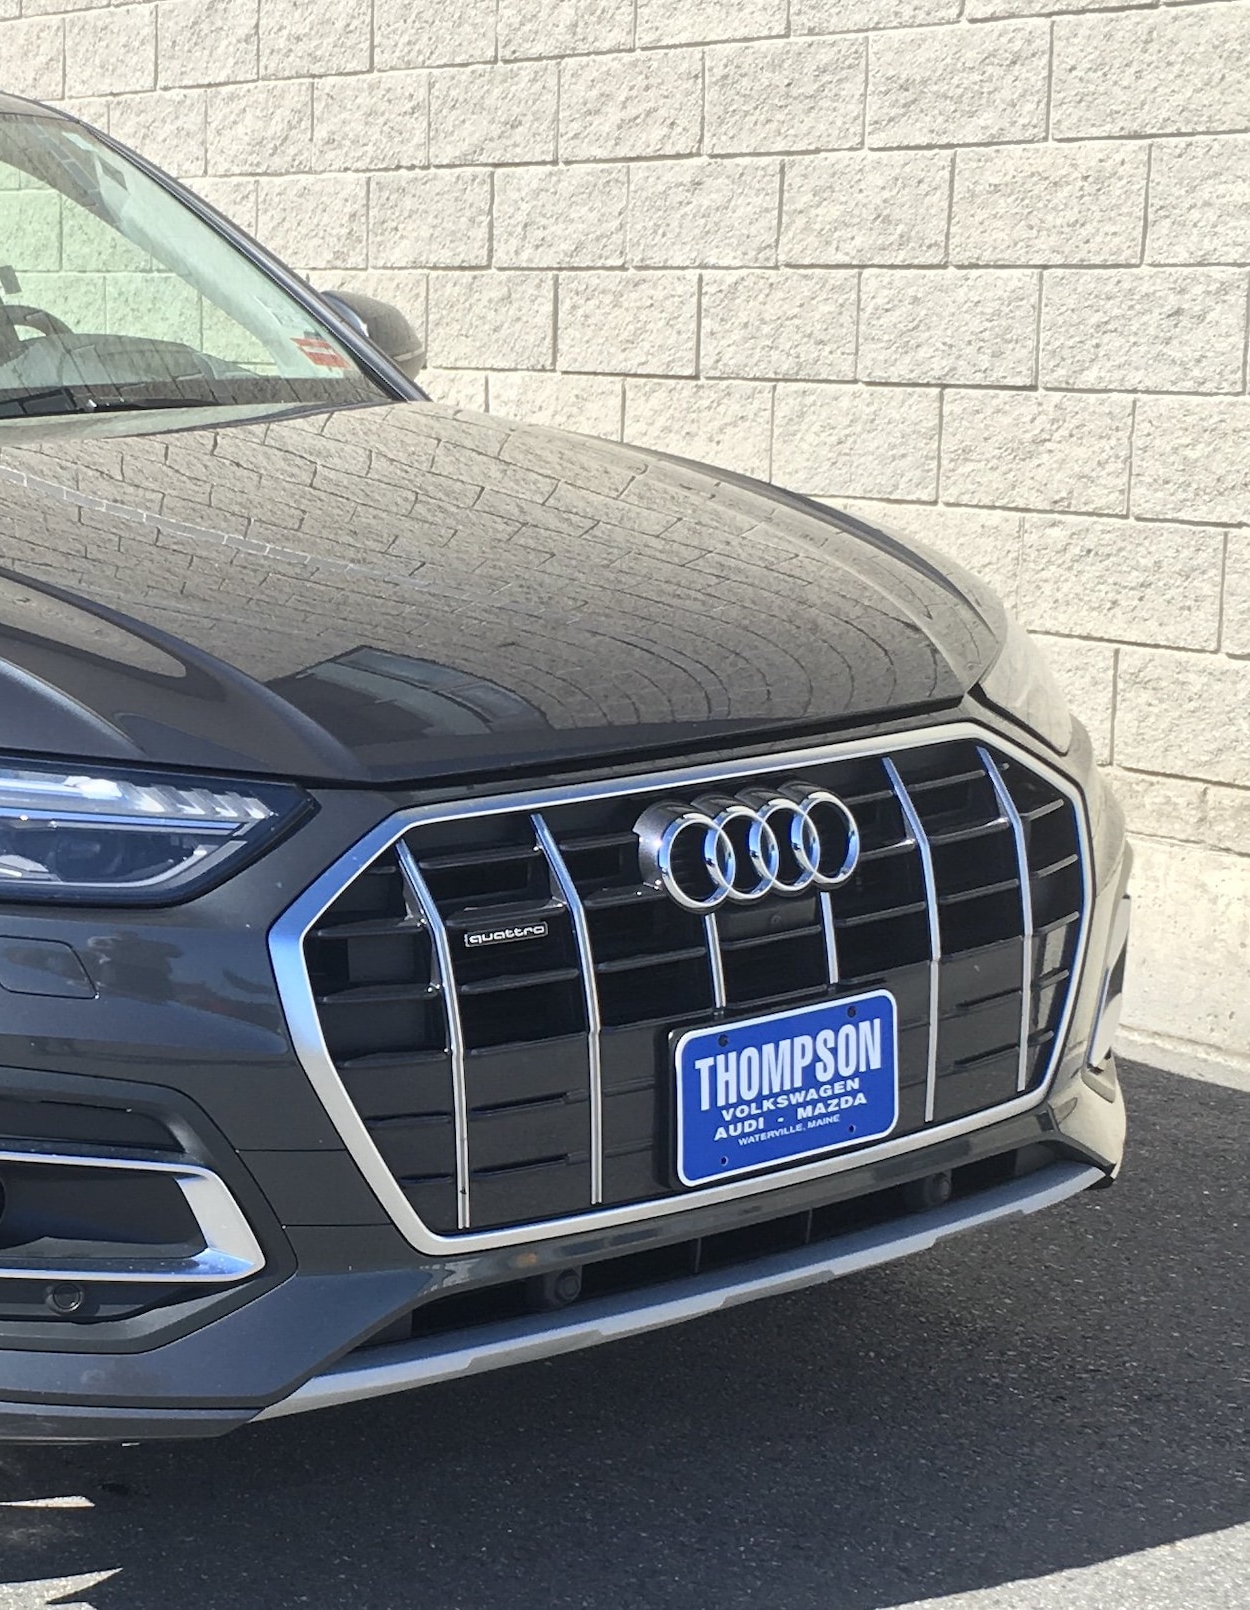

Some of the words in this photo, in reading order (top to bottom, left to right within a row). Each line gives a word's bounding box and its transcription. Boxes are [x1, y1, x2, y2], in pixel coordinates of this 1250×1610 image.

[469, 925, 545, 944] quattro
[694, 1018, 882, 1111] THOMPSON
[713, 1116, 765, 1141] AUDI
[796, 1092, 868, 1121] MAZDA
[721, 1077, 860, 1122] VOLKSWAGEN
[807, 1114, 841, 1129] MAINE
